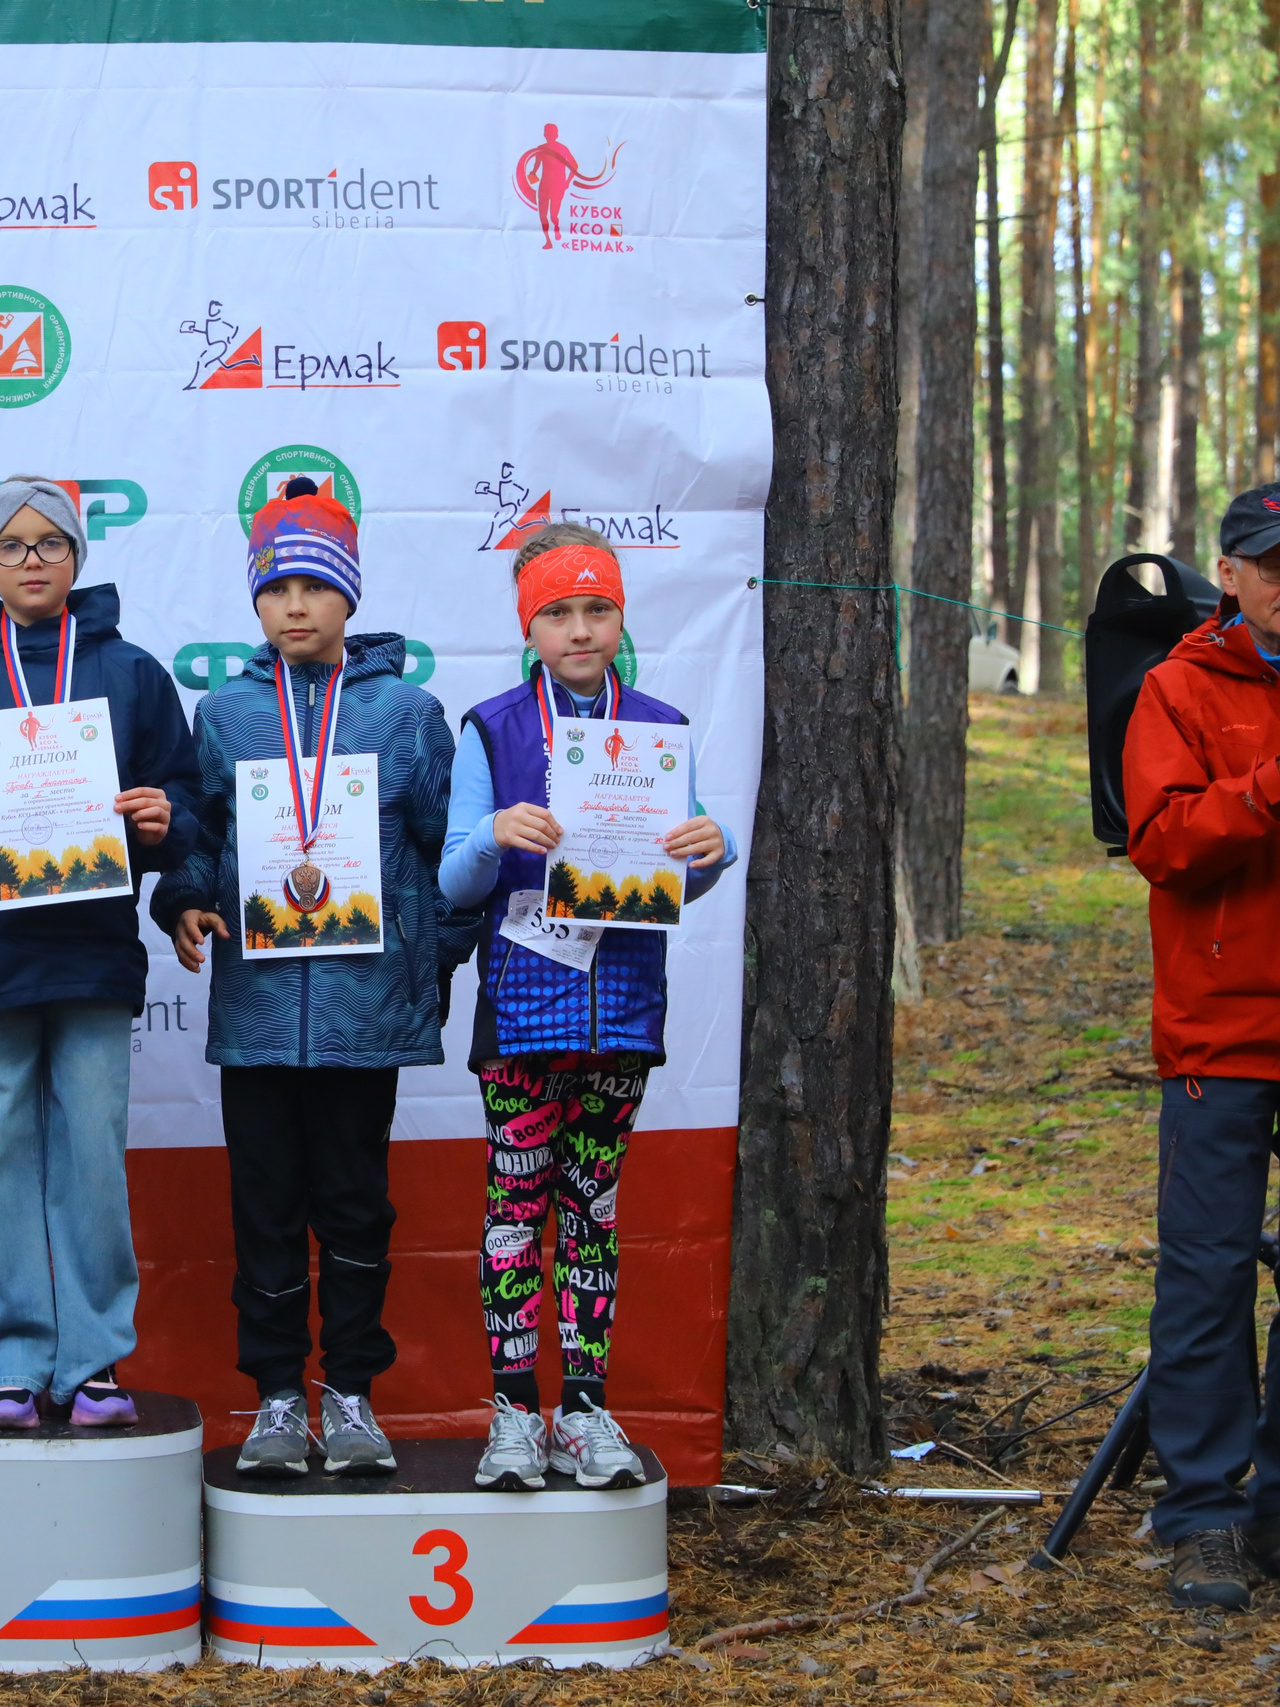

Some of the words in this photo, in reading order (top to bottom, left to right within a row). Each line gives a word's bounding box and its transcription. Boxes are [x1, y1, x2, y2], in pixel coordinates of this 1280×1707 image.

[213, 168, 440, 210] SPORTident
[312, 212, 394, 230] siberia
[570, 206, 622, 220] КУБОК
[570, 223, 603, 236] КСО
[562, 240, 634, 253] «ЕРМАК»
[42, 314, 65, 389] ОРИЕНТИРОВАНИЯ
[502, 332, 710, 378] SPORTident
[275, 342, 400, 390] Ермак
[596, 376, 672, 395] siberia
[245, 462, 271, 508] ФЕДЕРАЦИЯ
[276, 451, 336, 469] СПОРТИВНОГО
[83, 713, 103, 721] Ермак
[664, 741, 684, 750] Ермак
[10, 750, 78, 769] ДИПЛОМ
[18, 768, 75, 780] НАГРАЖДАЕТСЯ
[352, 767, 372, 775] Ермак
[589, 774, 655, 788] ДИПЛОМ
[594, 793, 650, 802] НАГРАЖДАЕТСЯ
[275, 804, 343, 819] ДИОМ
[304, 896, 312, 908] 3
[486, 1083, 532, 1112] love
[495, 1270, 542, 1300] love
[408, 1528, 474, 1626] 3
